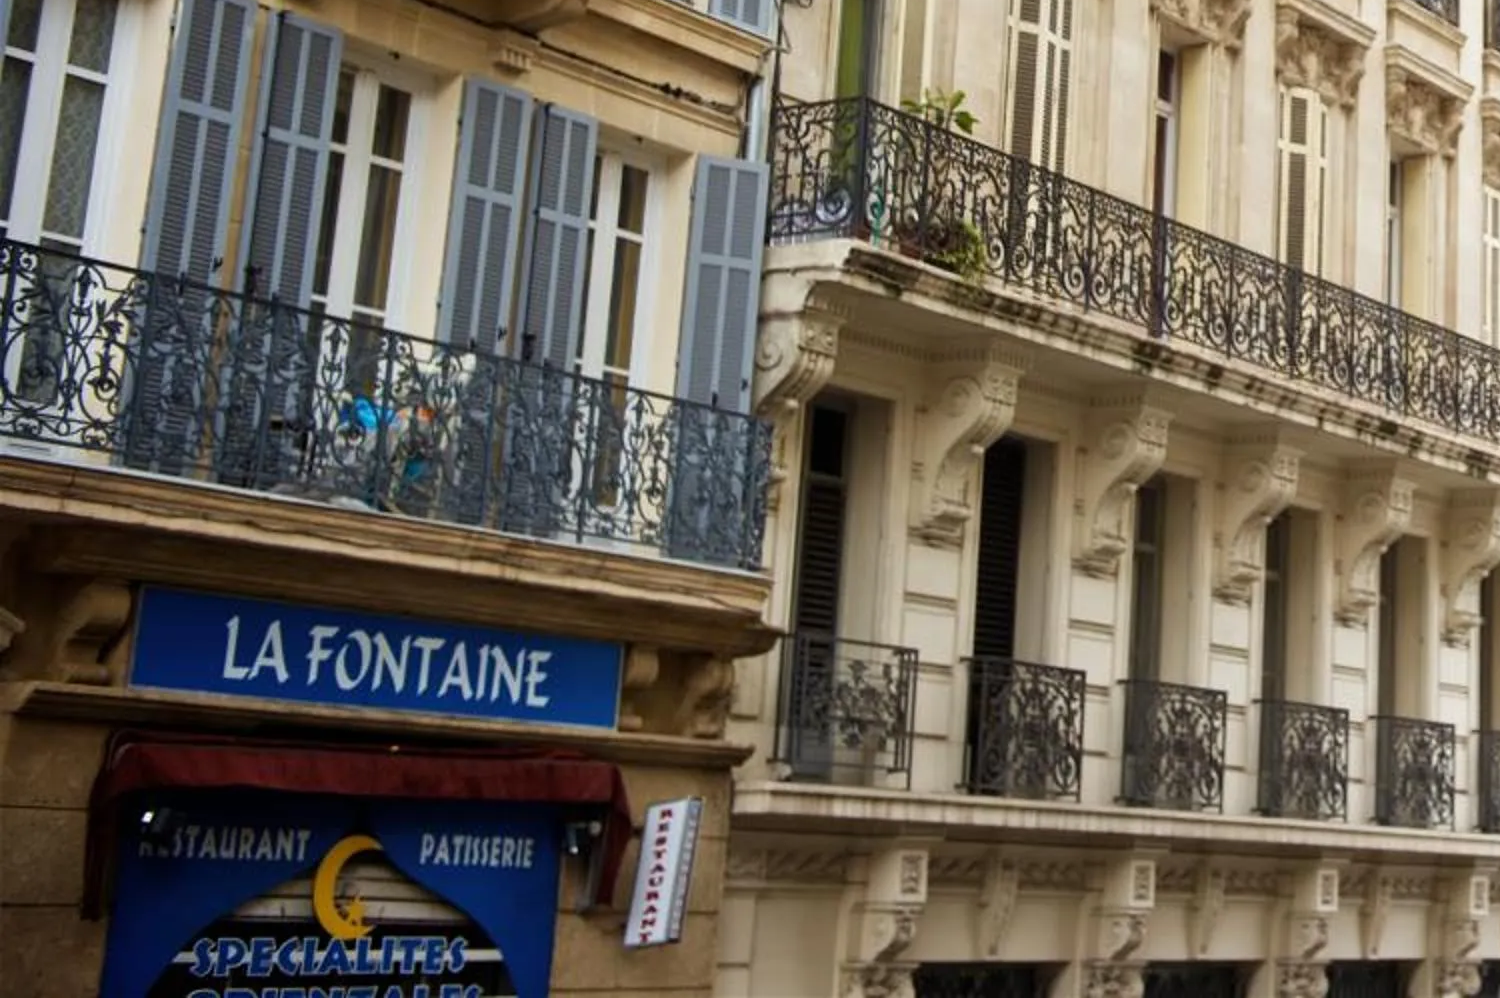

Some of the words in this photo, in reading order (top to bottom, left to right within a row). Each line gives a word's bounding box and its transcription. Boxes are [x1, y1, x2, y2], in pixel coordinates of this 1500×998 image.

[222, 615, 290, 684] LA
[306, 625, 553, 708] FONTAINE
[419, 833, 534, 869] PATISSERIE
[640, 809, 673, 943] RESTAURANT
[190, 935, 469, 977] SPECIALITES
